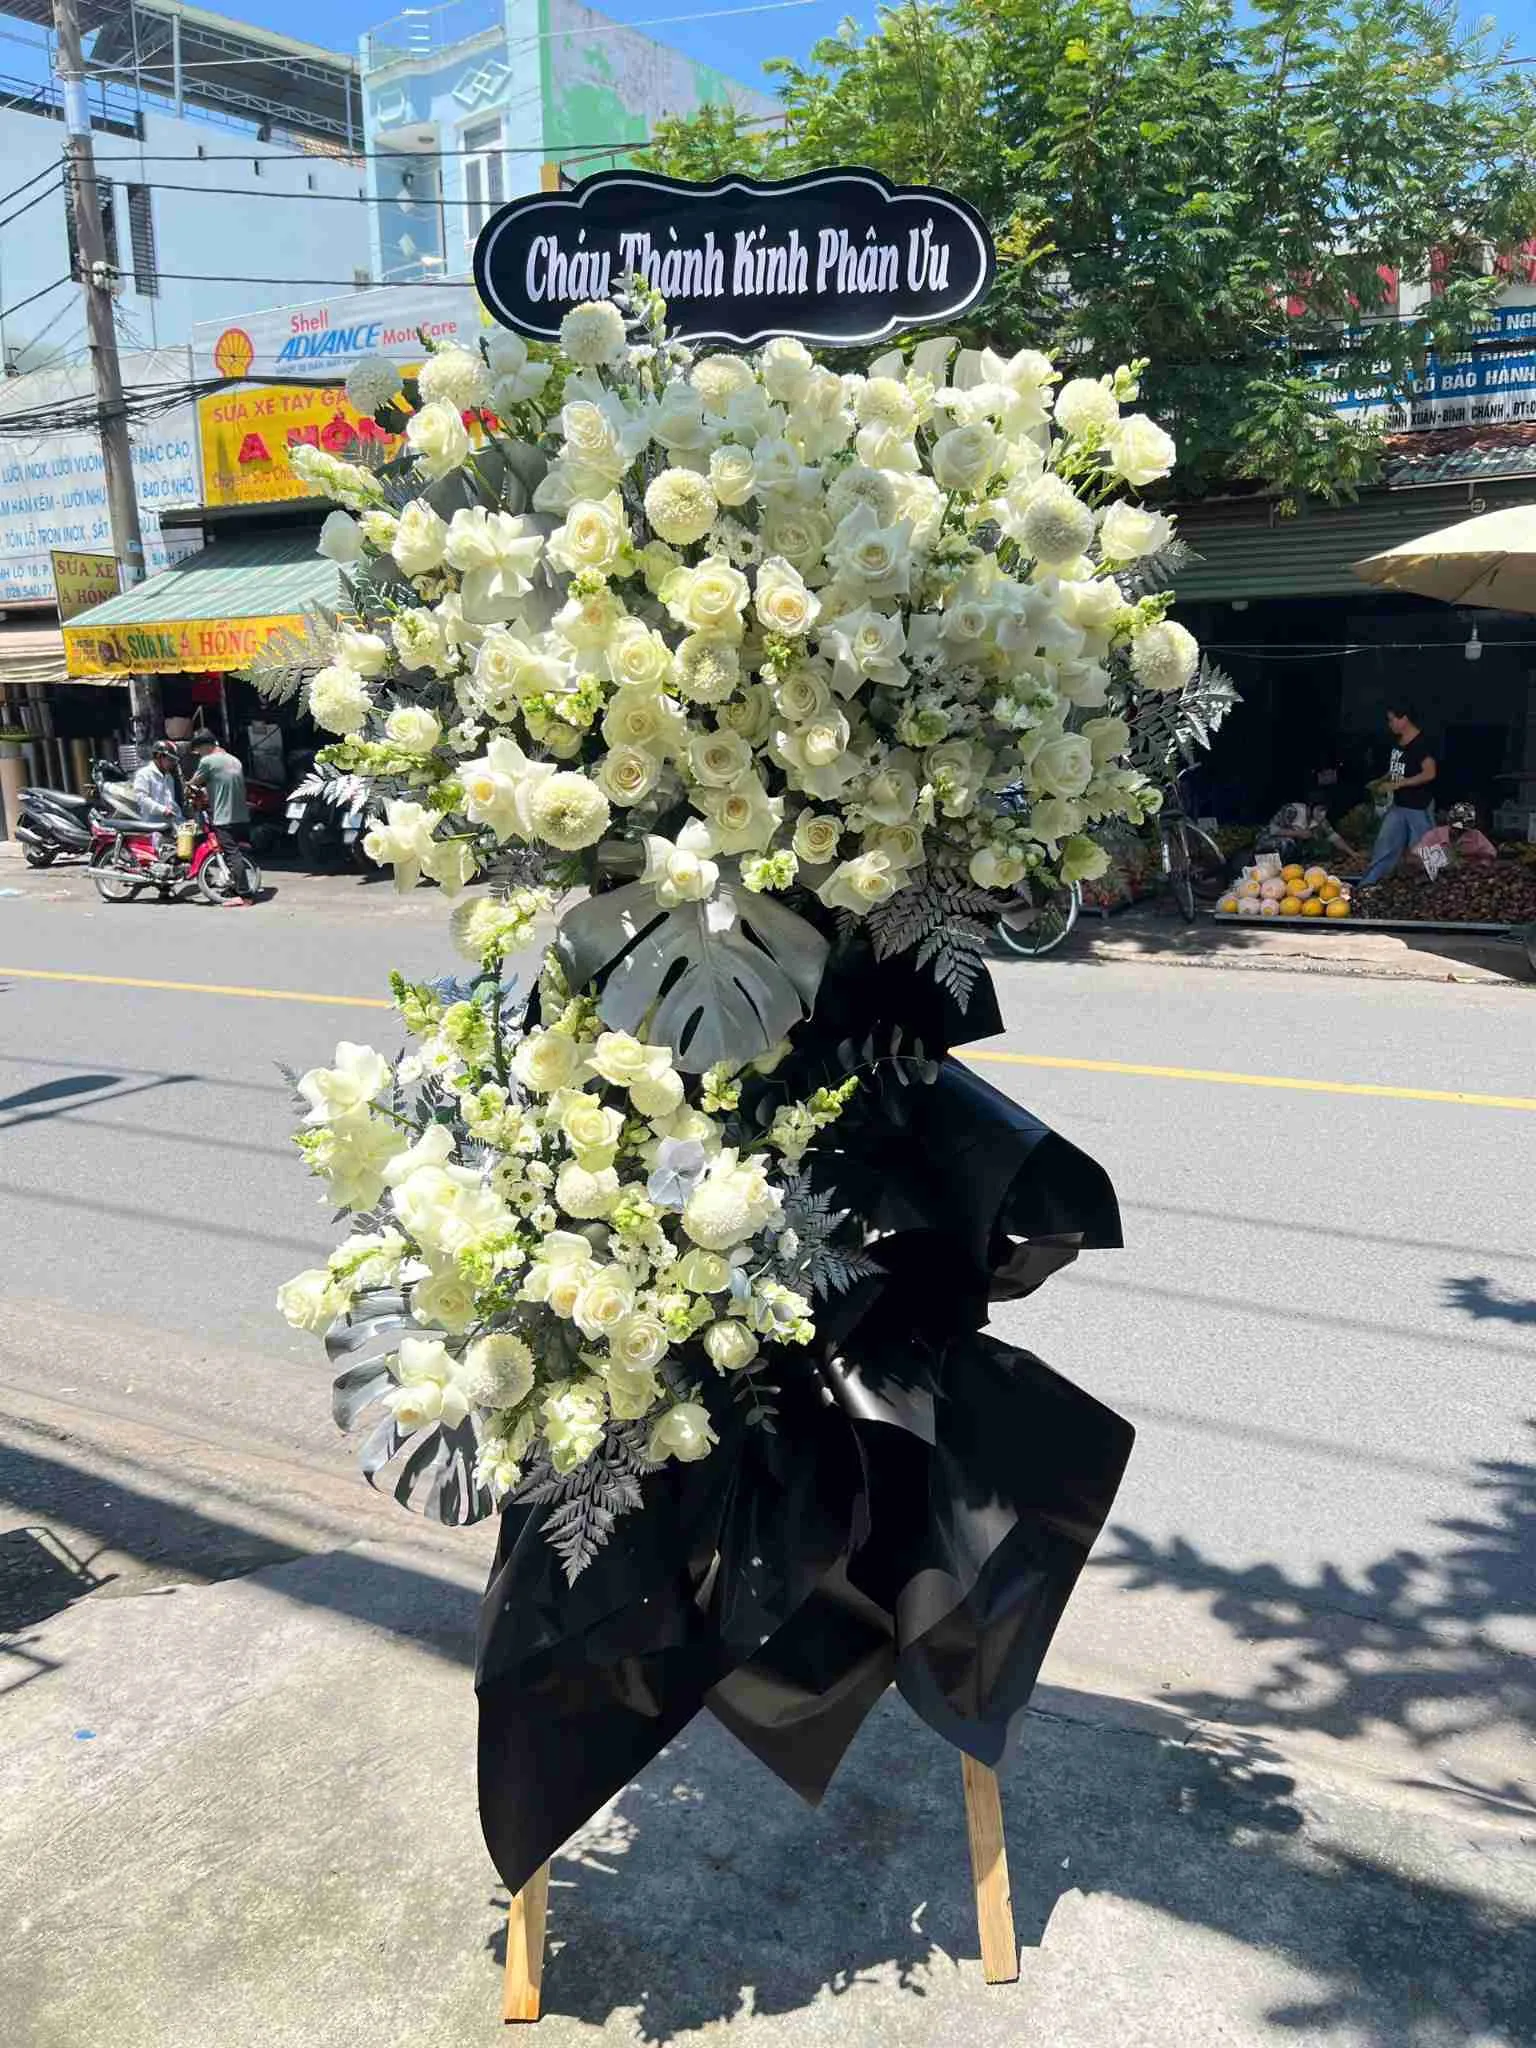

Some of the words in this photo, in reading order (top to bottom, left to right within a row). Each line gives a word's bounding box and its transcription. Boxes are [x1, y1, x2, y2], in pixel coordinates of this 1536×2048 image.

[525, 228, 611, 302] Cháu
[620, 225, 725, 299] Thành
[733, 224, 809, 297] Kính
[816, 225, 900, 294] Phân
[907, 217, 950, 292] Ưu
[290, 309, 328, 334] Shell
[275, 321, 383, 364] ADVANCE
[1441, 367, 1477, 390] BẢO
[254, 399, 275, 417] XE
[283, 393, 315, 413] TAY
[238, 432, 273, 464] A
[96, 561, 113, 578] XE
